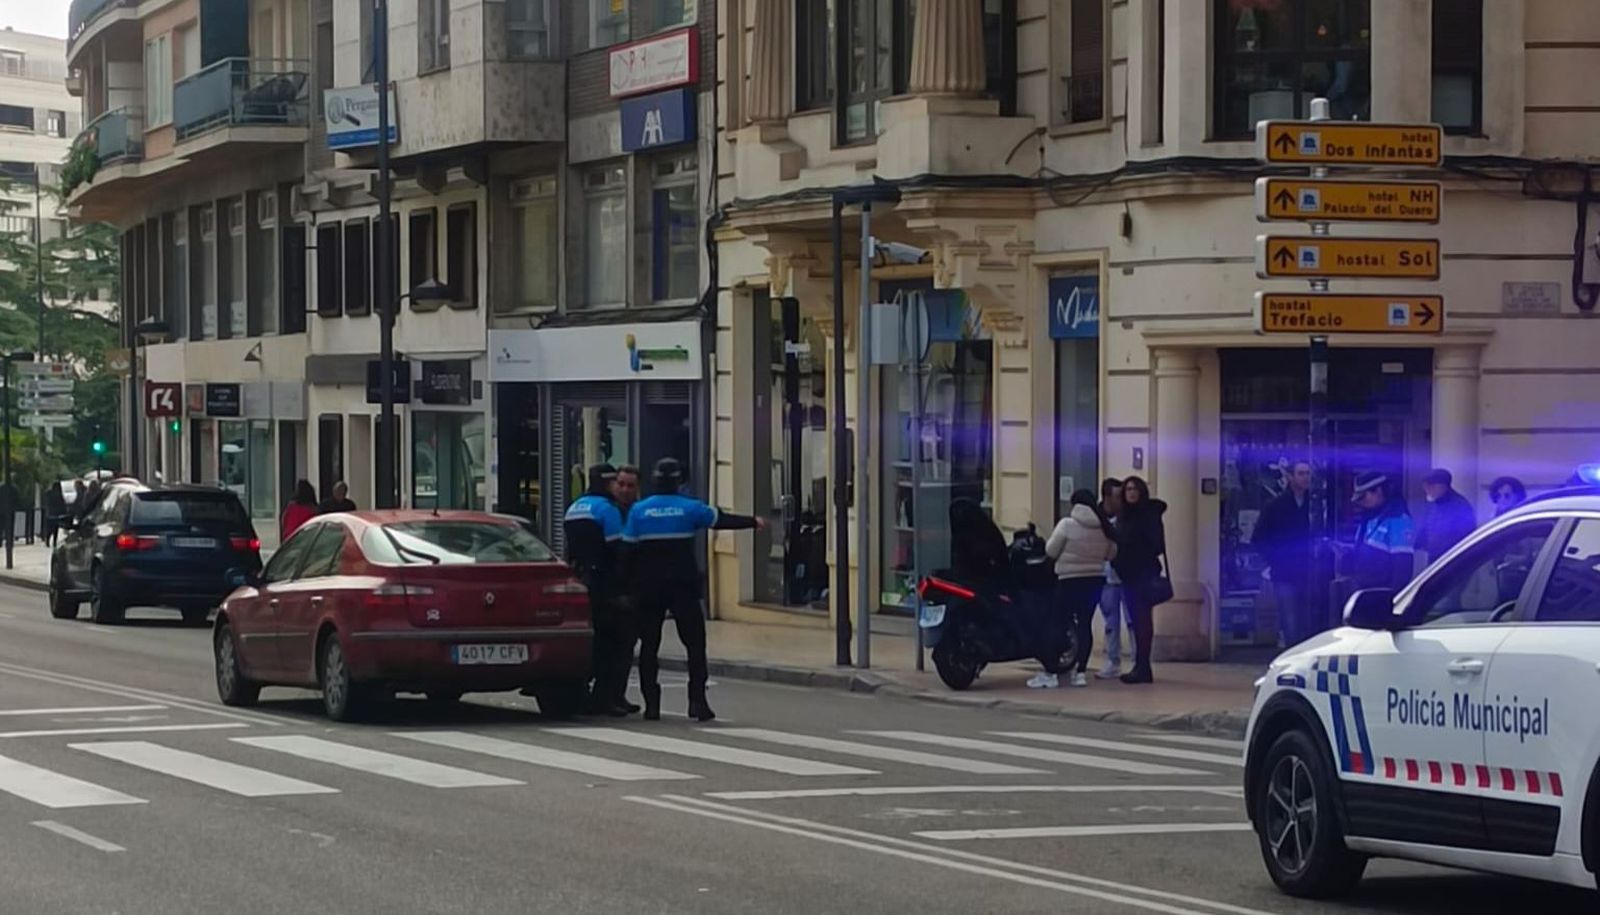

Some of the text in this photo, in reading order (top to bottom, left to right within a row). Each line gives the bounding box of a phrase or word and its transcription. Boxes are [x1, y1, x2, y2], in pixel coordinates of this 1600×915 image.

[1401, 132, 1433, 142] hotel
[1326, 143, 1433, 158] Dos Infantas
[1368, 190, 1433, 202] hotel NH
[1324, 203, 1433, 215] Palacio del Duero
[1337, 251, 1432, 266] hostal Sol
[1270, 300, 1311, 310] hostal
[1270, 313, 1343, 326] Trefacio
[461, 645, 524, 659] 4017 CFV
[1387, 687, 1549, 744] Policía Municipal
